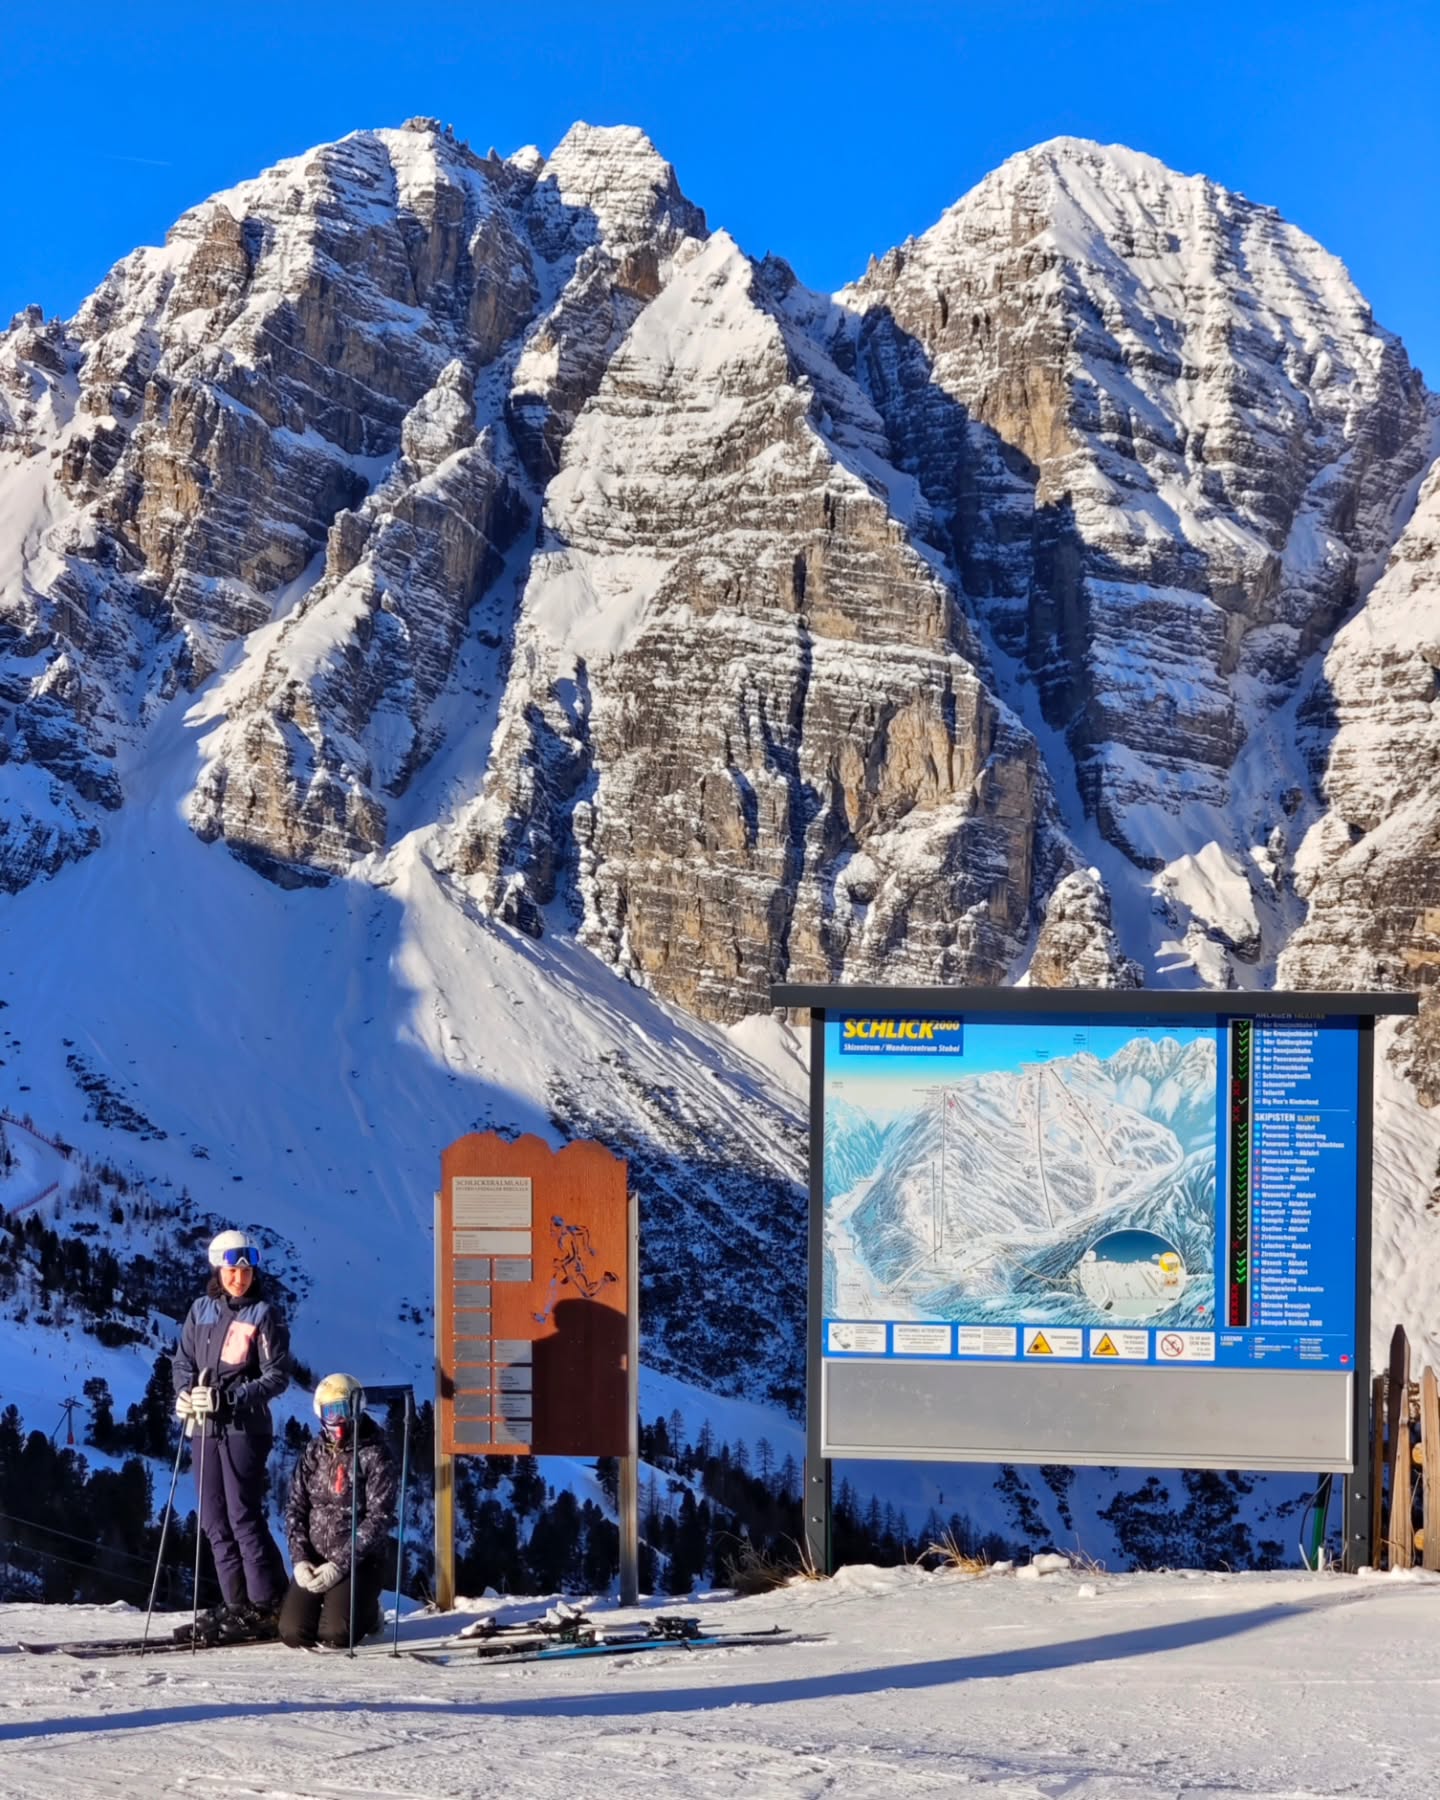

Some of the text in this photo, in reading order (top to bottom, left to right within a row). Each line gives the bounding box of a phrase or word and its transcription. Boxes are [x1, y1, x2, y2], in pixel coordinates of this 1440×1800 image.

[843, 1018, 960, 1039] SCHLICK 2000
[843, 1043, 880, 1051] Skizentrum
[886, 1044, 937, 1052] Wanderzentrum
[1255, 1113, 1295, 1121] SKIPISTEN
